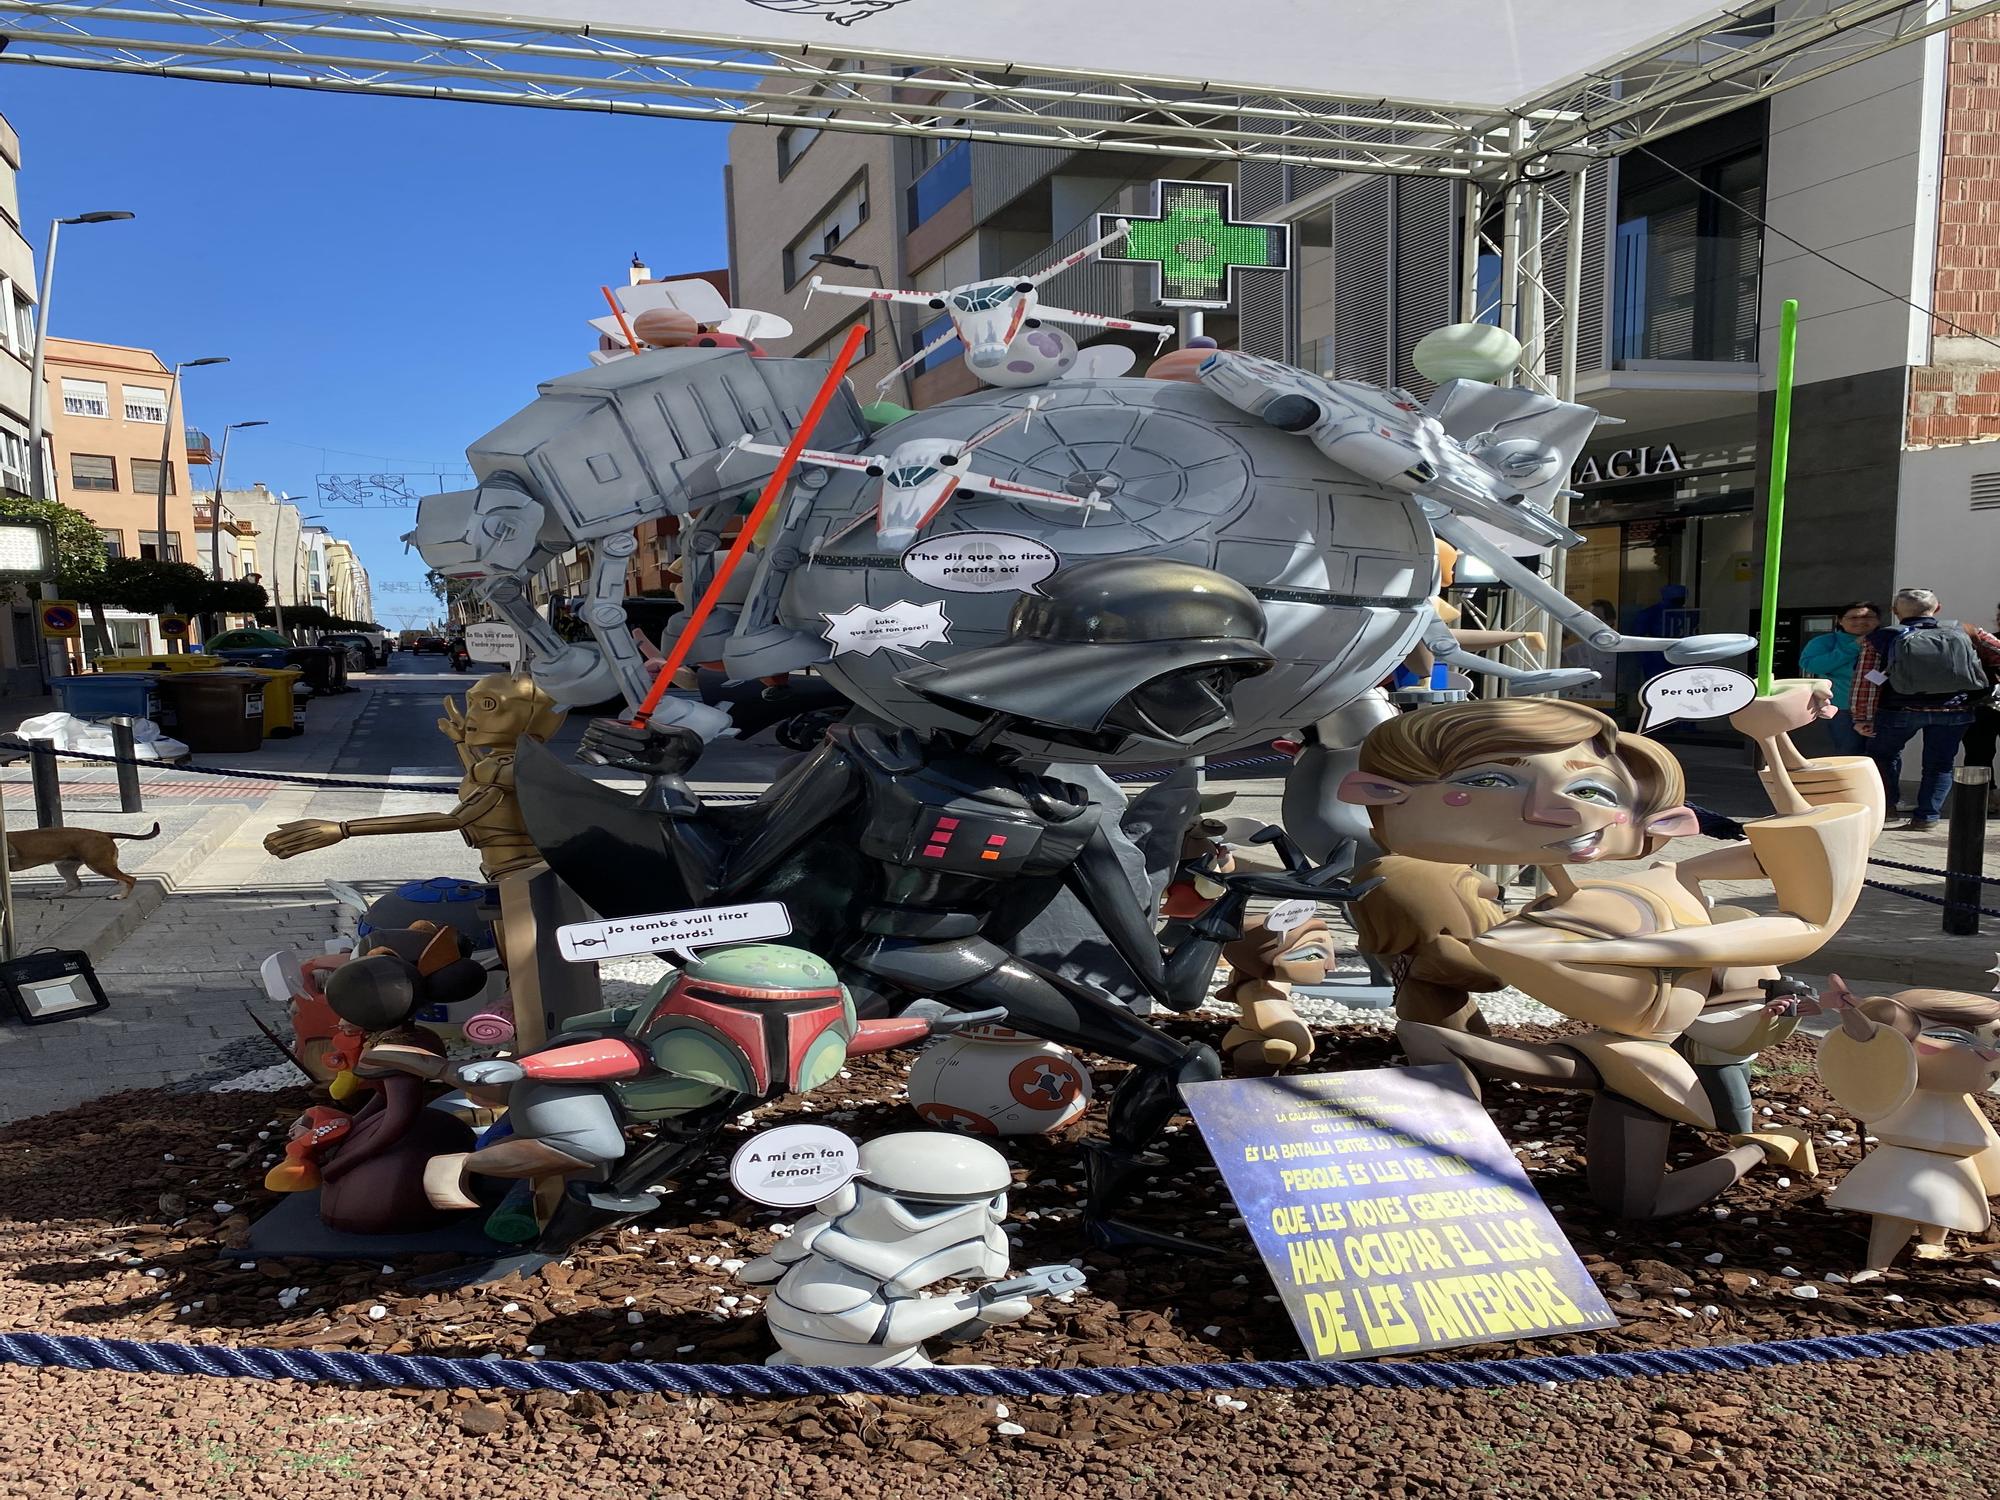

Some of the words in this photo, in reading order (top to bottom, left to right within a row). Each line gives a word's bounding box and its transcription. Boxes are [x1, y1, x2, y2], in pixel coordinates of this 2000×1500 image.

[1573, 443, 1684, 485] ACIA
[908, 553, 939, 561] T'he
[945, 553, 963, 561] dit
[968, 554, 993, 562] que
[943, 566, 995, 575] petards
[1000, 565, 1019, 573] ací
[850, 629, 867, 637] que
[1713, 684, 1734, 692] no?
[608, 926, 624, 935] Jo
[630, 919, 679, 932] també
[683, 915, 713, 926] vull
[718, 911, 749, 922] tirar
[651, 928, 715, 945] petards!
[749, 1153, 762, 1163] A
[767, 1152, 786, 1162] mi
[792, 1151, 815, 1160] em
[820, 1149, 844, 1158] fan
[1245, 1144, 1259, 1161] ÉS
[1262, 1145, 1279, 1160] LA
[1281, 1141, 1334, 1159] BATALLA
[1335, 1137, 1374, 1154] ENTRE
[1371, 1136, 1392, 1150] LO
[771, 1165, 822, 1178] temor!
[1370, 1160, 1409, 1183] LLEI
[1403, 1157, 1435, 1180] DE
[1272, 1205, 1314, 1236] QUE
[1311, 1202, 1347, 1231] LES
[1347, 1196, 1410, 1228] NOVES
[1287, 1239, 1345, 1285] HAN
[1344, 1227, 1456, 1279] OCUPAR
[1441, 1225, 1494, 1266] EL
[1475, 1217, 1562, 1262] LLOC
[1304, 1291, 1361, 1356] DE
[1352, 1284, 1420, 1349] LES
